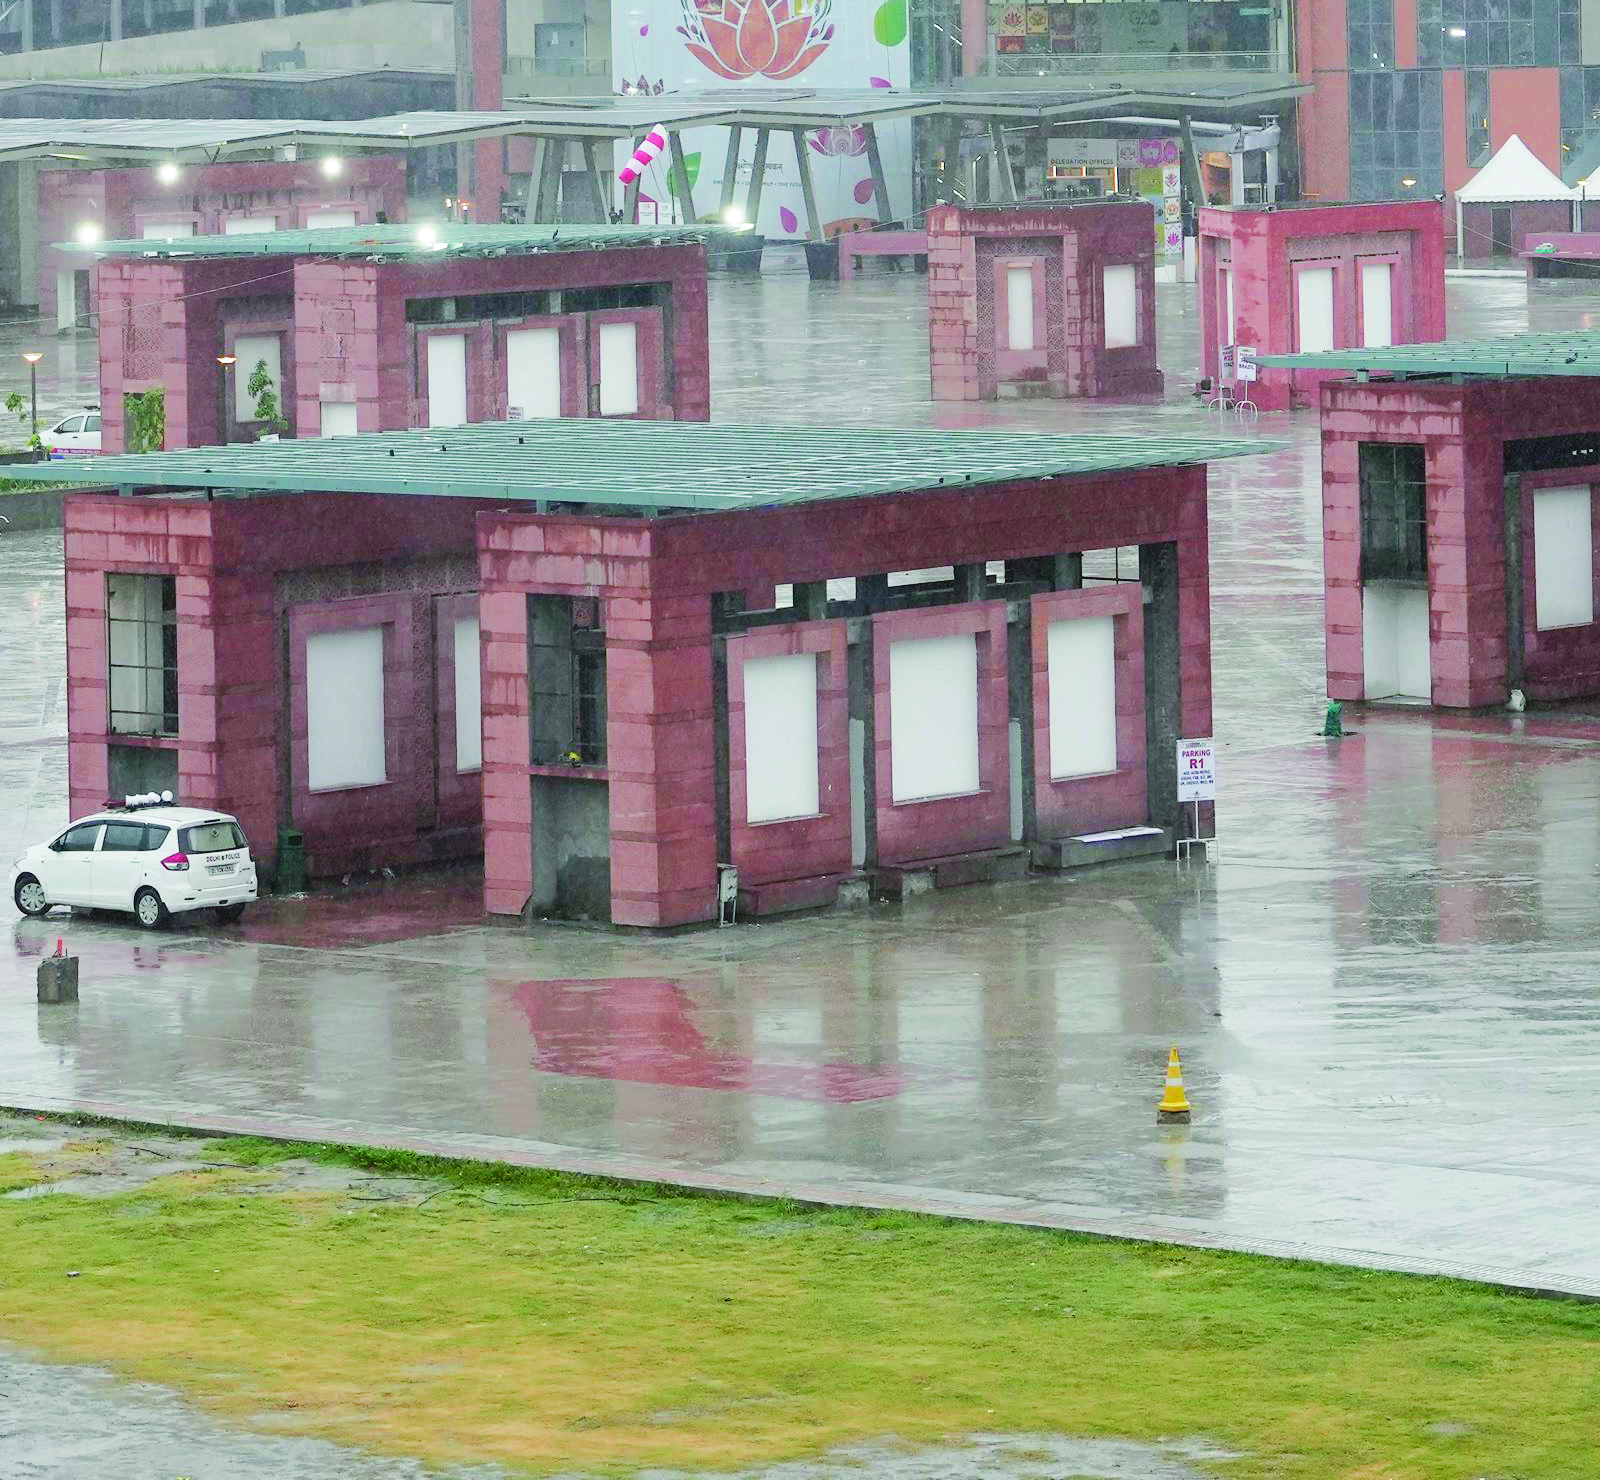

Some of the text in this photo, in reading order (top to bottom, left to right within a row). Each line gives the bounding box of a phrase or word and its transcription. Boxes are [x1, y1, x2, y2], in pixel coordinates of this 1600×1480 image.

[1181, 749, 1211, 757] PARKING
[1189, 758, 1204, 769] R1
[225, 852, 241, 860] POLICE
